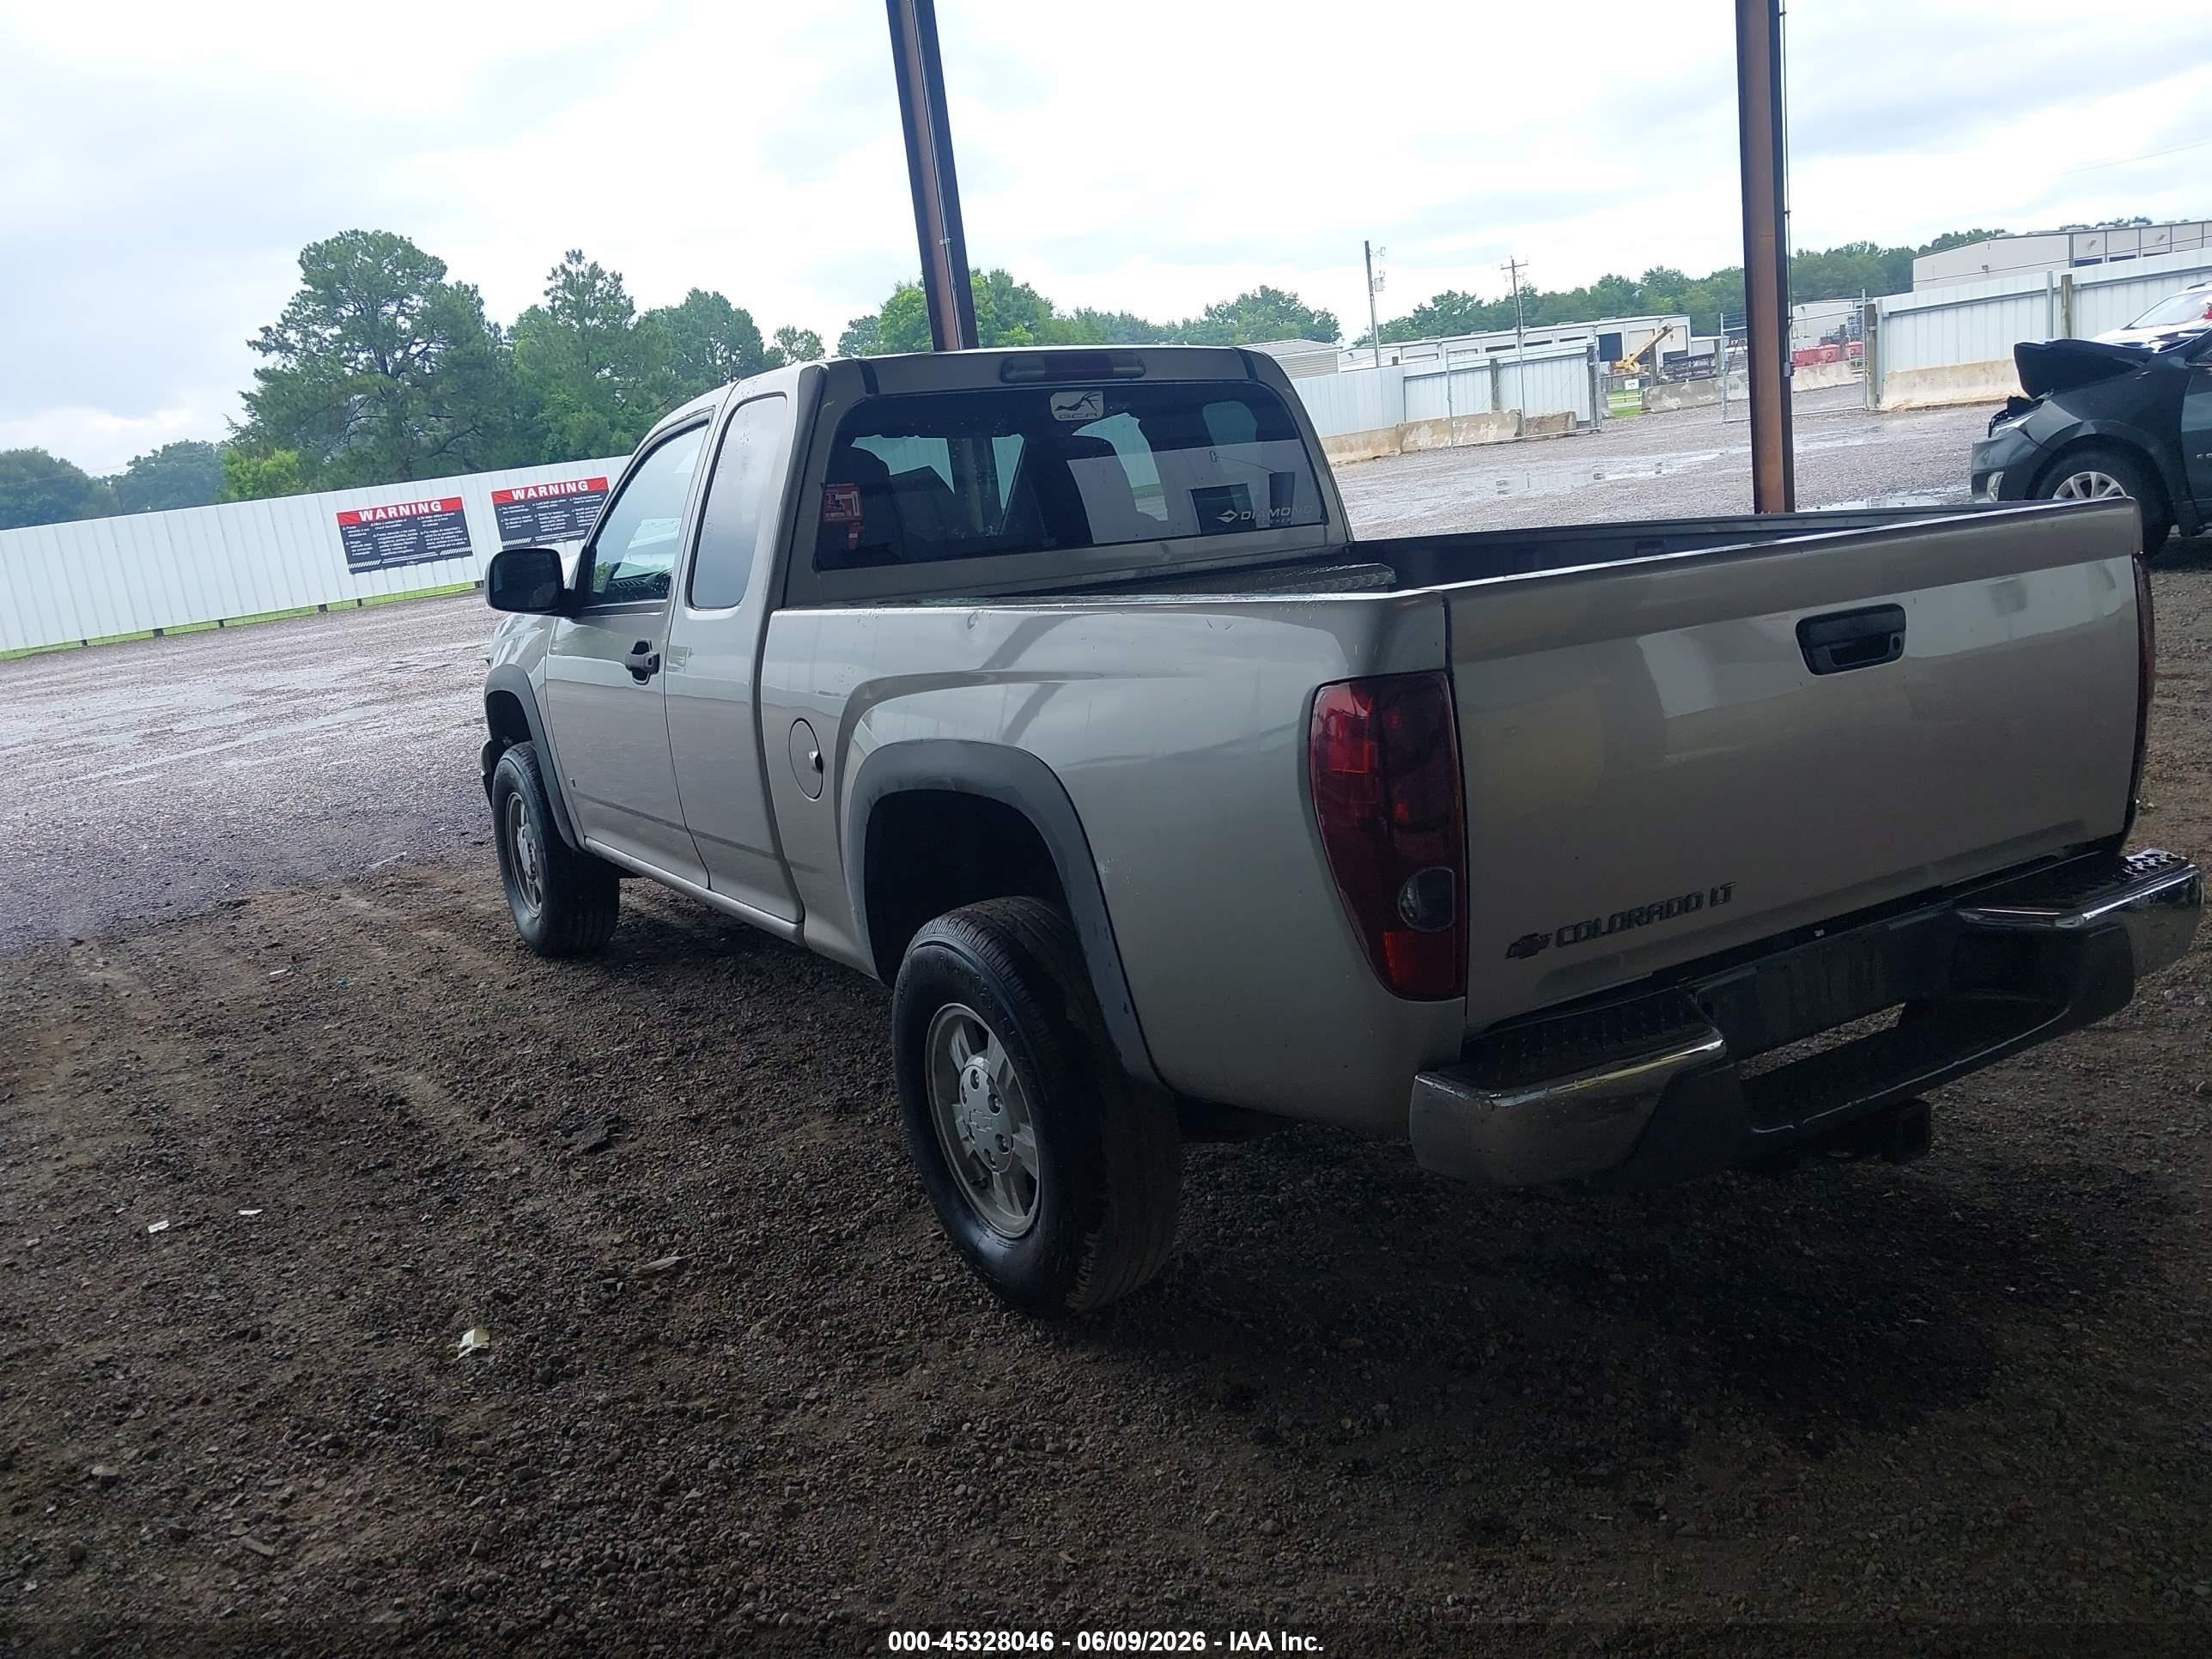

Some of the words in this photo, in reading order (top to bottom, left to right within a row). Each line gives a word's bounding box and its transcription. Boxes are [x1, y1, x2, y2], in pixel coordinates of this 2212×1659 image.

[511, 480, 589, 501] WARNING
[358, 501, 443, 522] WARNING
[1240, 505, 1313, 520] DIAMOND
[1554, 891, 1705, 948] COLORADO
[1710, 881, 1737, 907] LT
